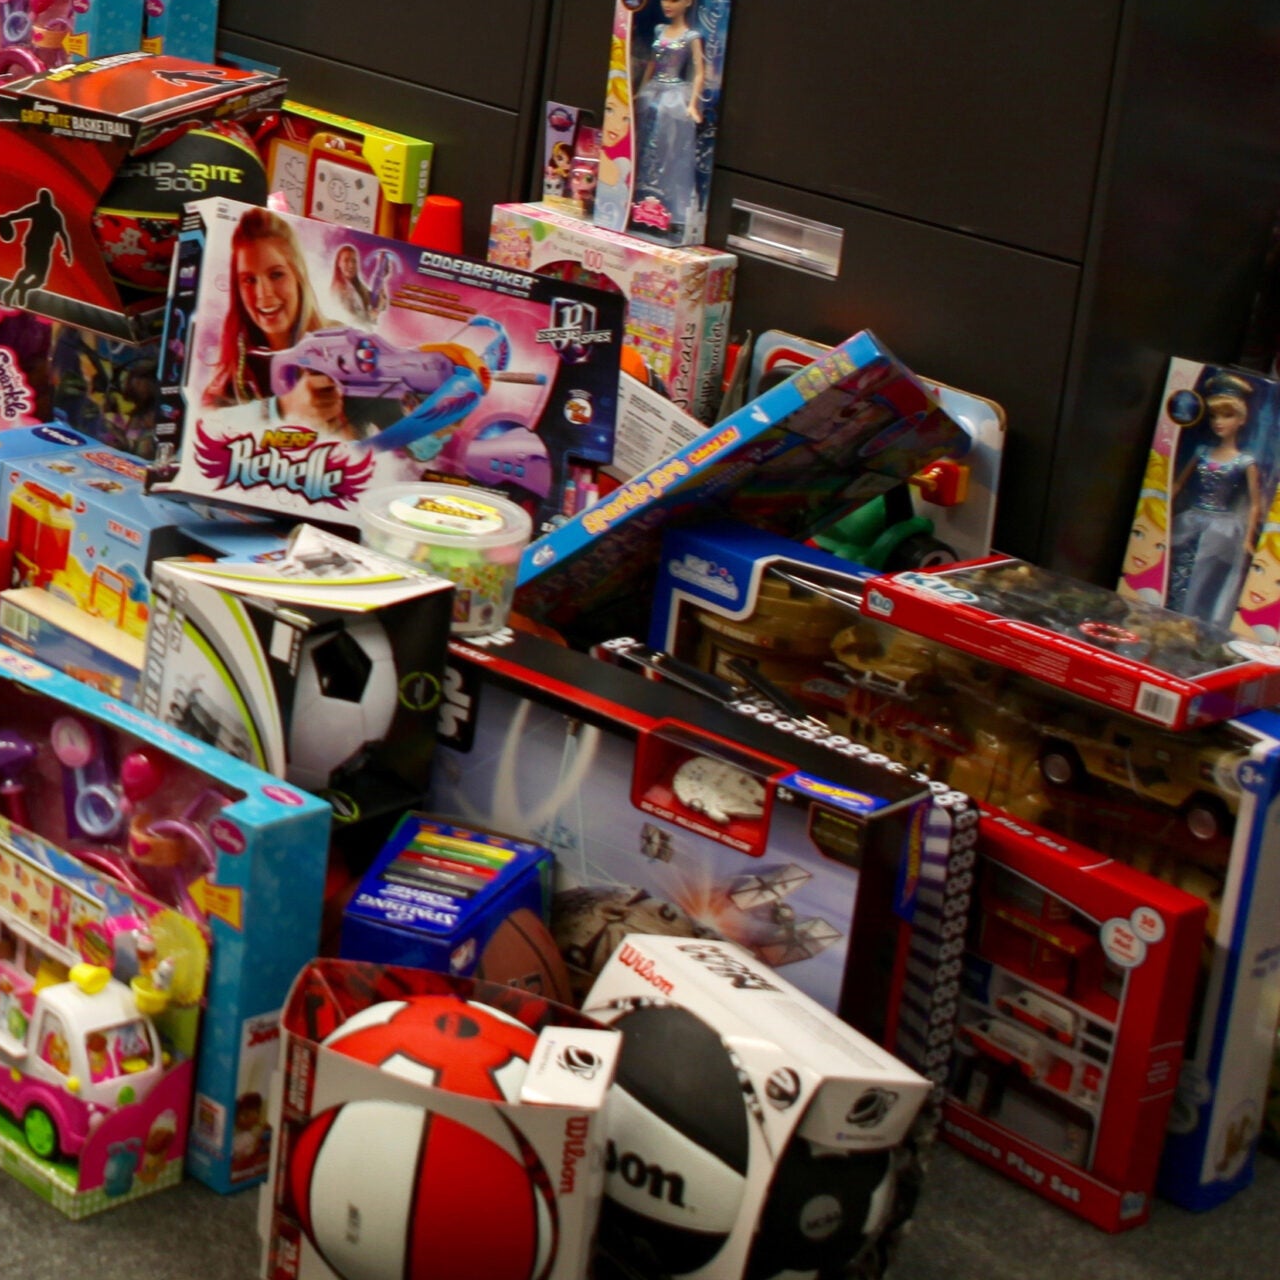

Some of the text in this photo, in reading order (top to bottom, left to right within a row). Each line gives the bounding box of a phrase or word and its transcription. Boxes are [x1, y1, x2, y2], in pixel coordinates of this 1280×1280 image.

[21, 108, 71, 129] GRIP-RITE
[71, 115, 132, 138] BASKETBALL
[155, 177, 207, 192] 300
[419, 250, 534, 291] CODEBREAKER
[536, 324, 581, 344] SECRETS
[40, 426, 81, 447] vtech
[261, 428, 318, 450] NERF
[225, 438, 344, 501] Rebelle
[106, 519, 142, 543] TRY ME!
[904, 570, 980, 603] KID
[869, 592, 893, 613] KID
[776, 786, 794, 801] 5+
[640, 801, 753, 852] DIE-CAST MILLENNIUM FALCON
[992, 814, 1069, 854] Play Set
[615, 942, 675, 996] Wilson
[558, 1116, 589, 1196] Wilson
[1005, 1151, 1082, 1204] Play Set
